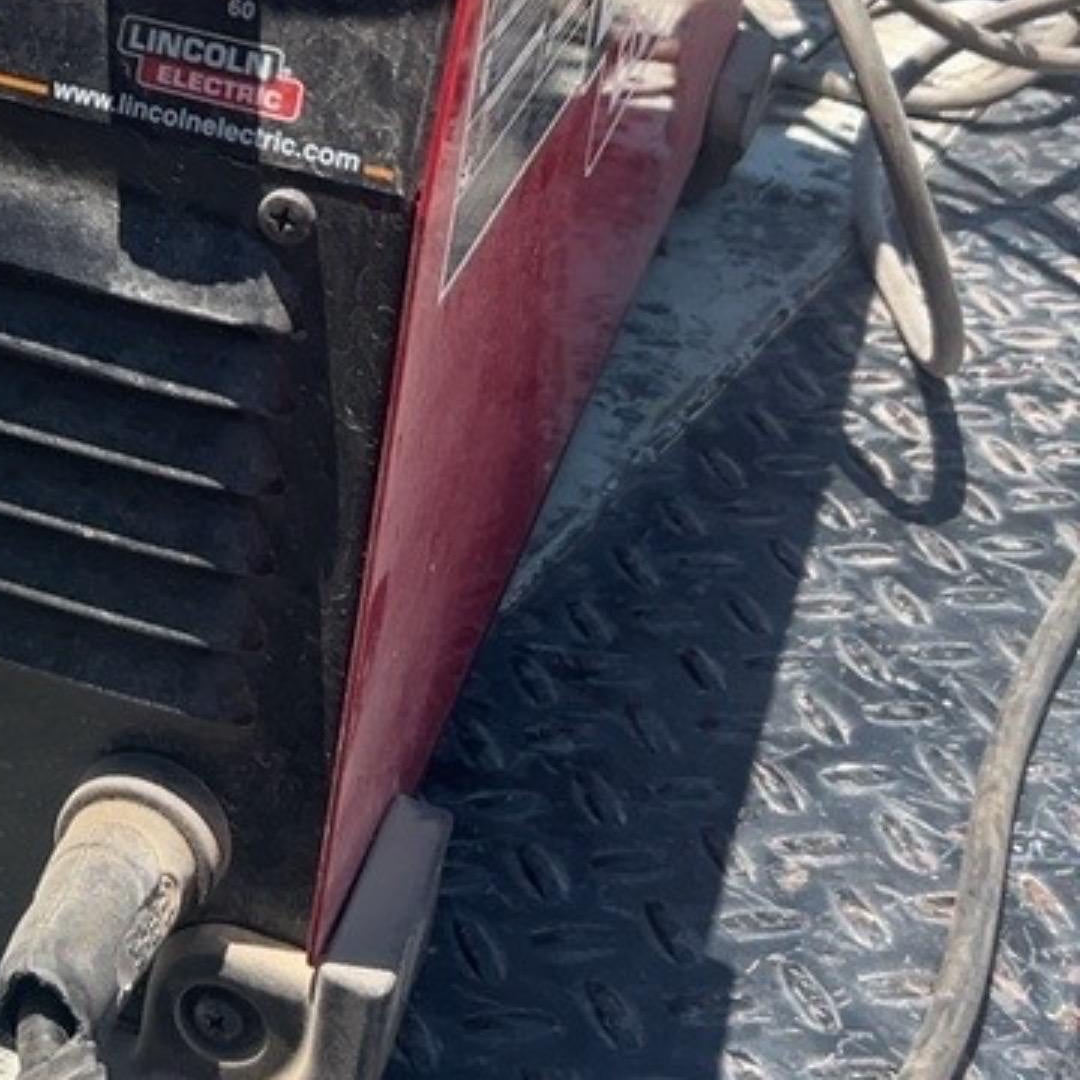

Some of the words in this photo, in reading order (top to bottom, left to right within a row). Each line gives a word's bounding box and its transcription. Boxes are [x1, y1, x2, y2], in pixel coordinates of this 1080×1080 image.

[127, 22, 274, 82] LINCOLN
[155, 64, 285, 111] ELECTRIC
[52, 79, 361, 173] www.lincolnelectric.com
